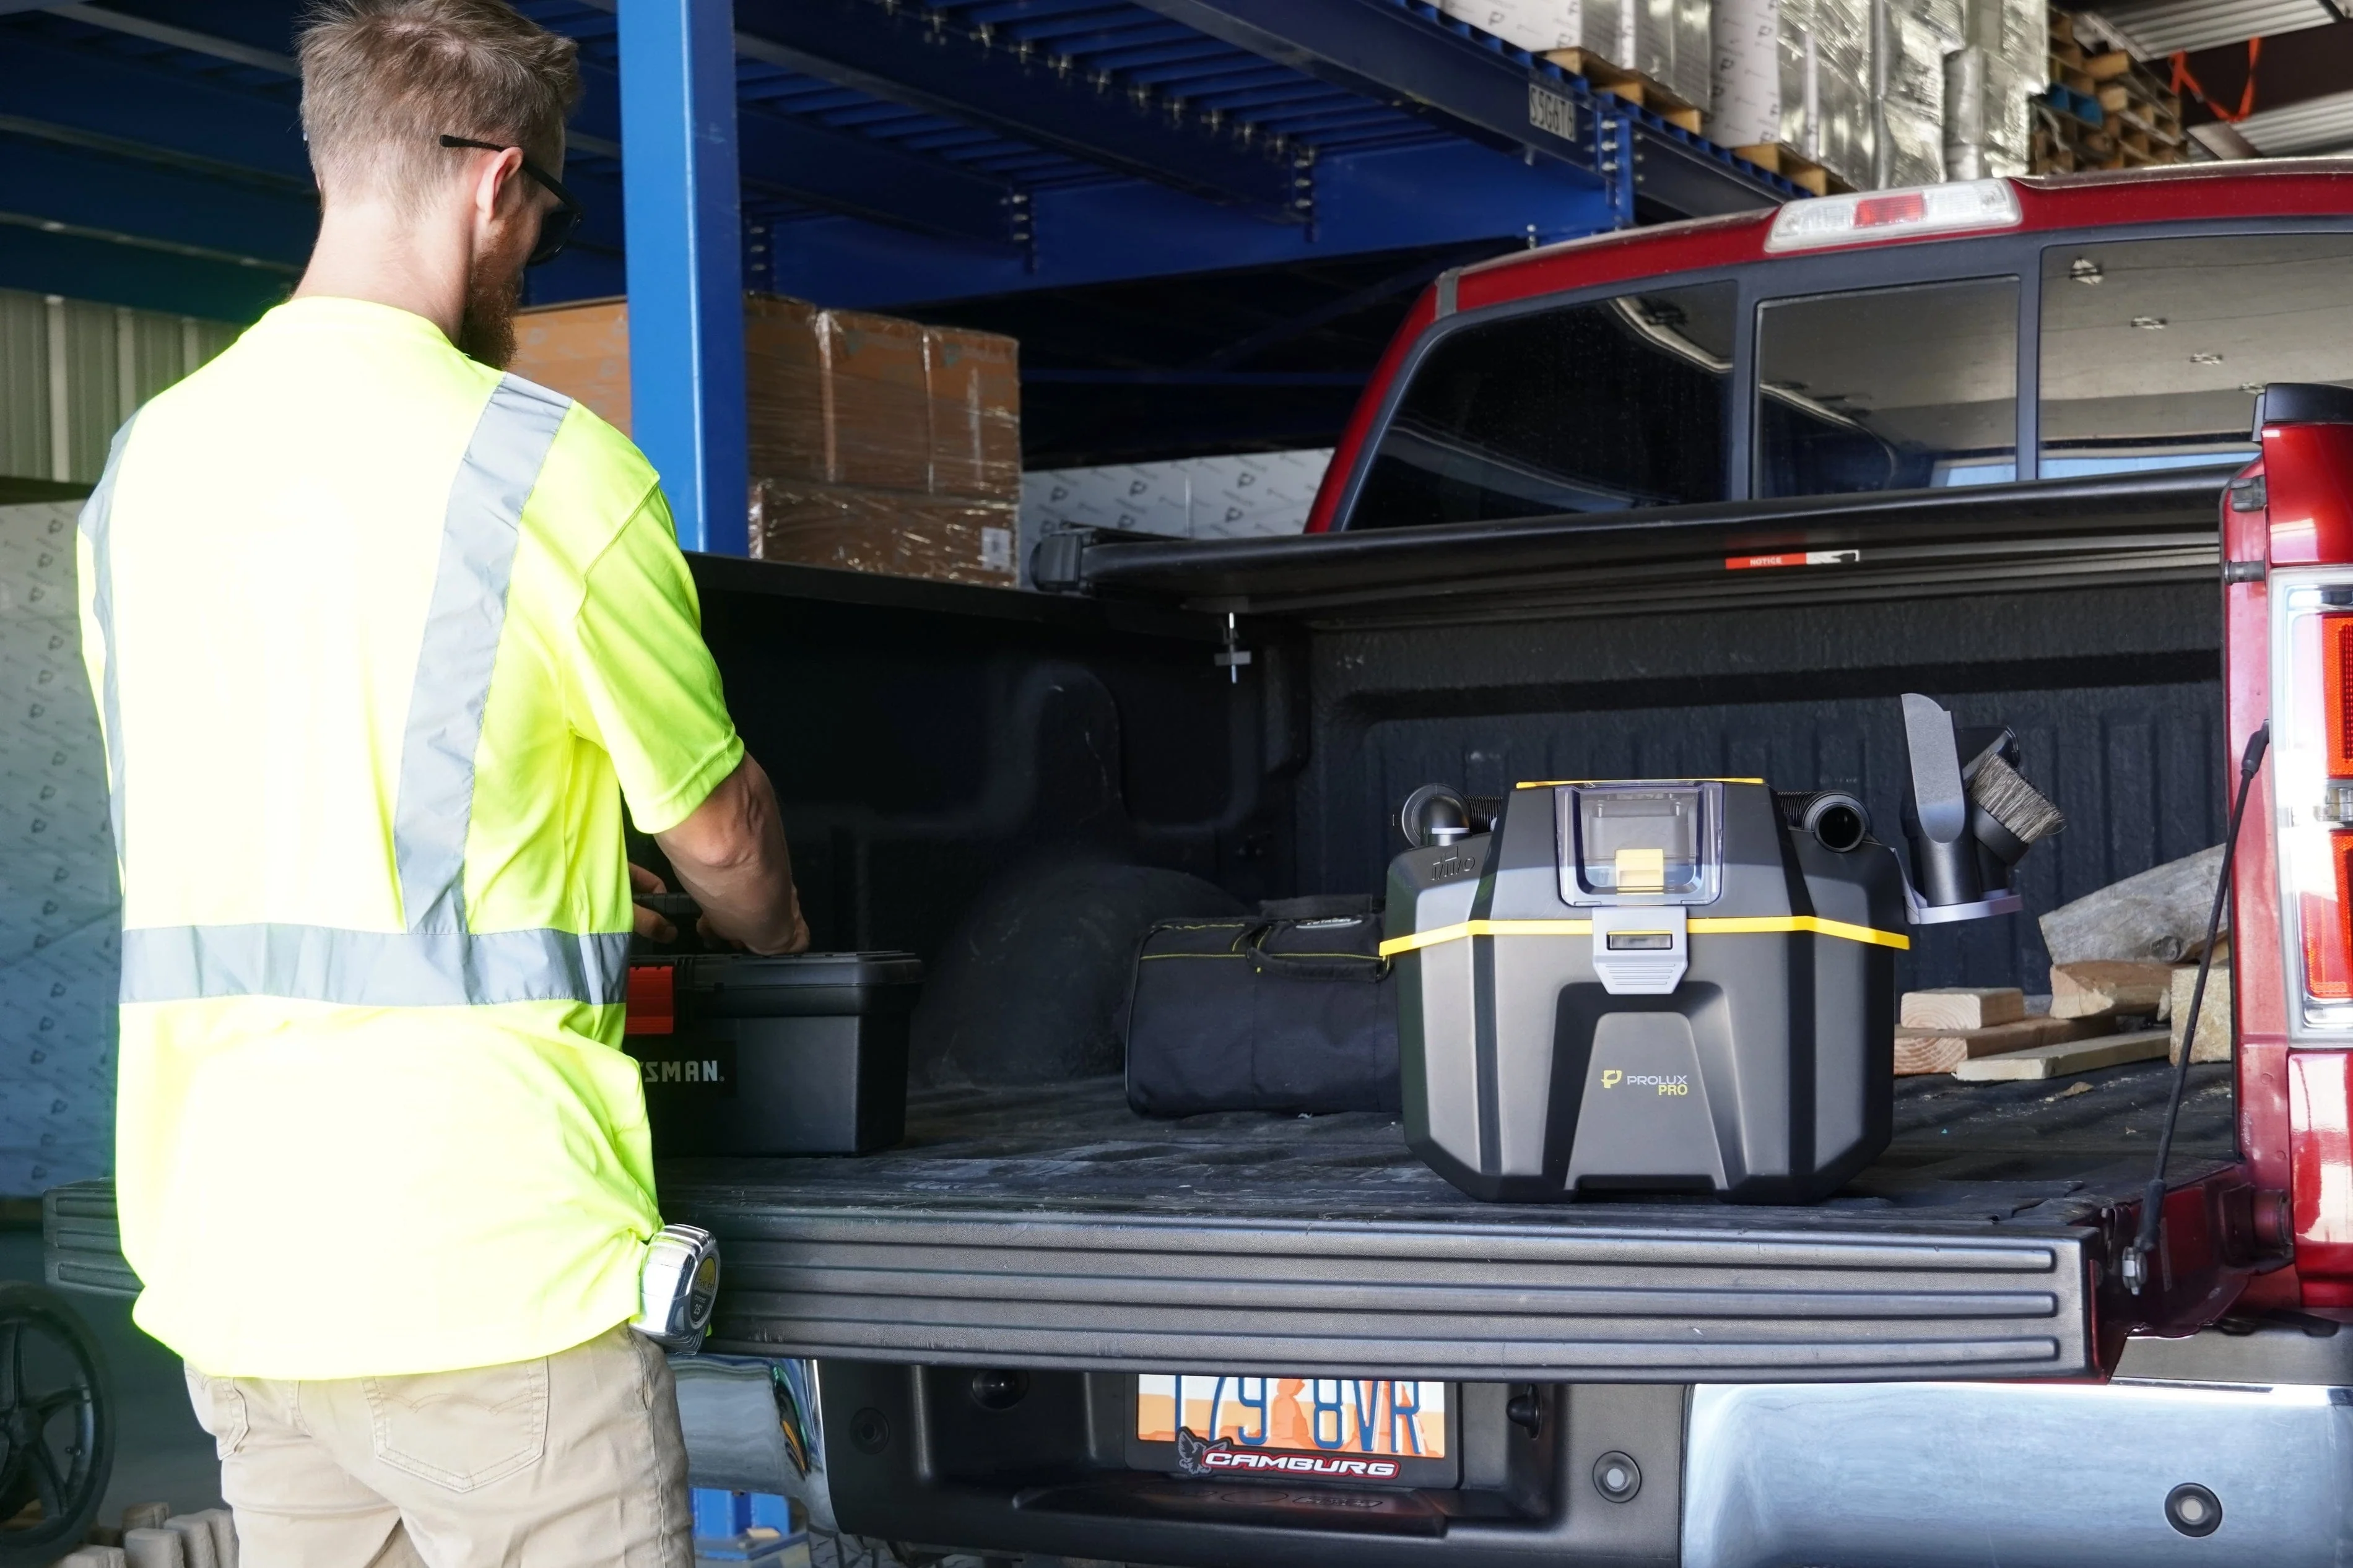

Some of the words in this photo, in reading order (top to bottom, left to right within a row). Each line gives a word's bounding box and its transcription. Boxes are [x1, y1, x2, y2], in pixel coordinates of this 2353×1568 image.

[1750, 557, 1782, 566] NOTICE
[640, 1060, 718, 1082] SMAN
[1627, 1075, 1687, 1085] PROLUX
[1658, 1085, 1688, 1096] PRO
[1313, 1378, 1423, 1454] 8VR
[1204, 1451, 1396, 1476] CAMBURG
